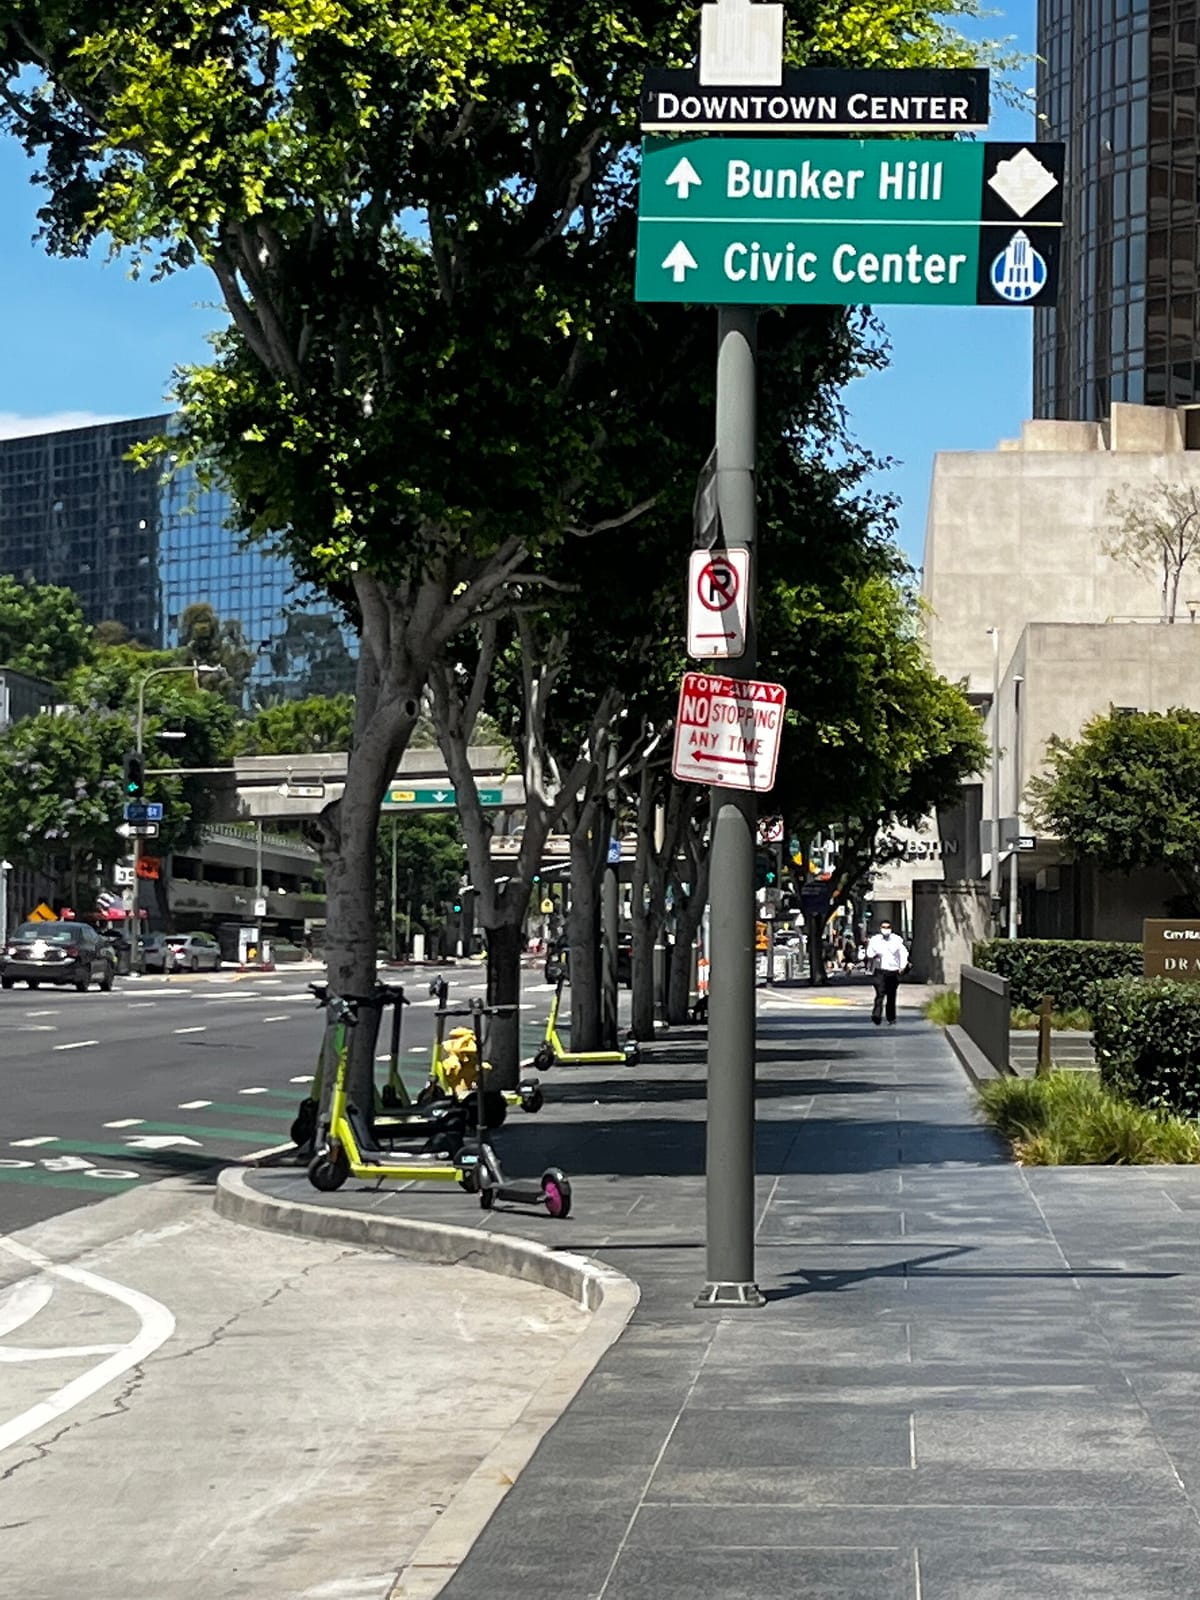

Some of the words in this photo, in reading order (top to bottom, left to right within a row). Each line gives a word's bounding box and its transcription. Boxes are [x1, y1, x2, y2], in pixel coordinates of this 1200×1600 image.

[726, 159, 865, 199] Bunker
[879, 160, 943, 200] Hill
[723, 241, 818, 283] Civic
[832, 243, 967, 284] Center
[687, 676, 782, 702] TOW-AWAY
[682, 694, 709, 724] NO
[712, 703, 777, 730] STOPPING
[688, 729, 719, 750] ANY
[729, 735, 765, 755] TIME
[897, 839, 959, 853] ESTIN
